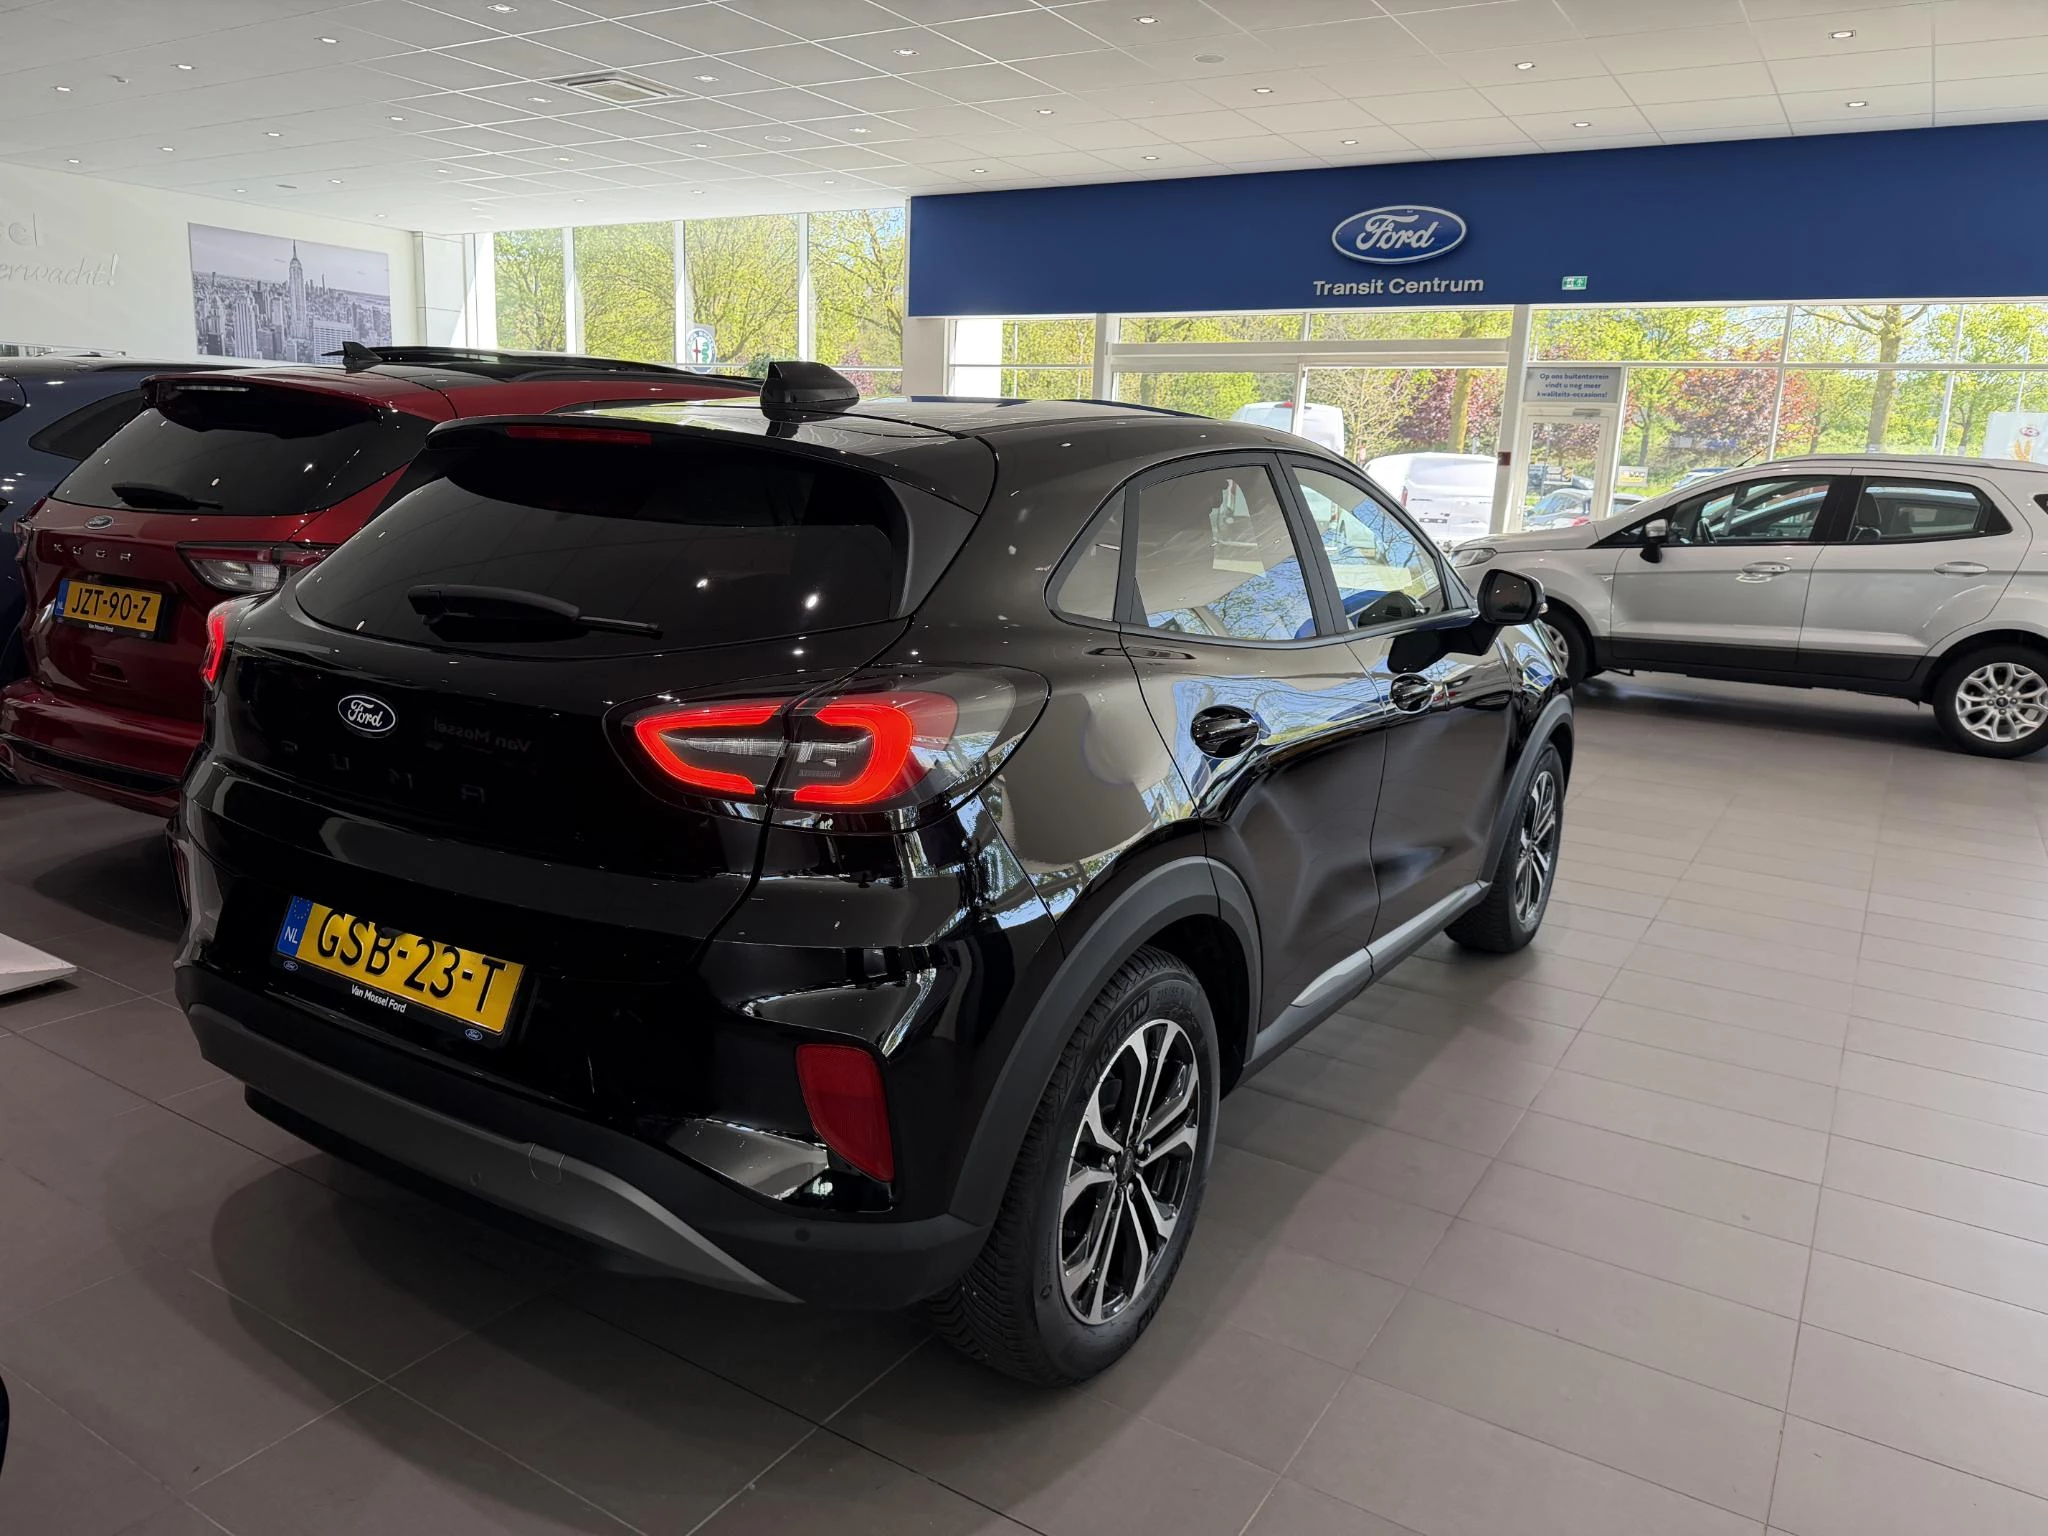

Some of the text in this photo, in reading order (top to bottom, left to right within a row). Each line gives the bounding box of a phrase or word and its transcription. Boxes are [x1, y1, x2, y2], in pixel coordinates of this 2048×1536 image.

[1356, 214, 1439, 250] Ford
[1313, 276, 1484, 297] Transit Centrum
[1539, 373, 1550, 381] Op
[71, 587, 151, 624] JZT-90-Z
[347, 699, 383, 727] Ford
[284, 926, 298, 945] NL
[317, 909, 508, 1013] GSB-23-T
[351, 984, 407, 1013] Van Mossel Ford
